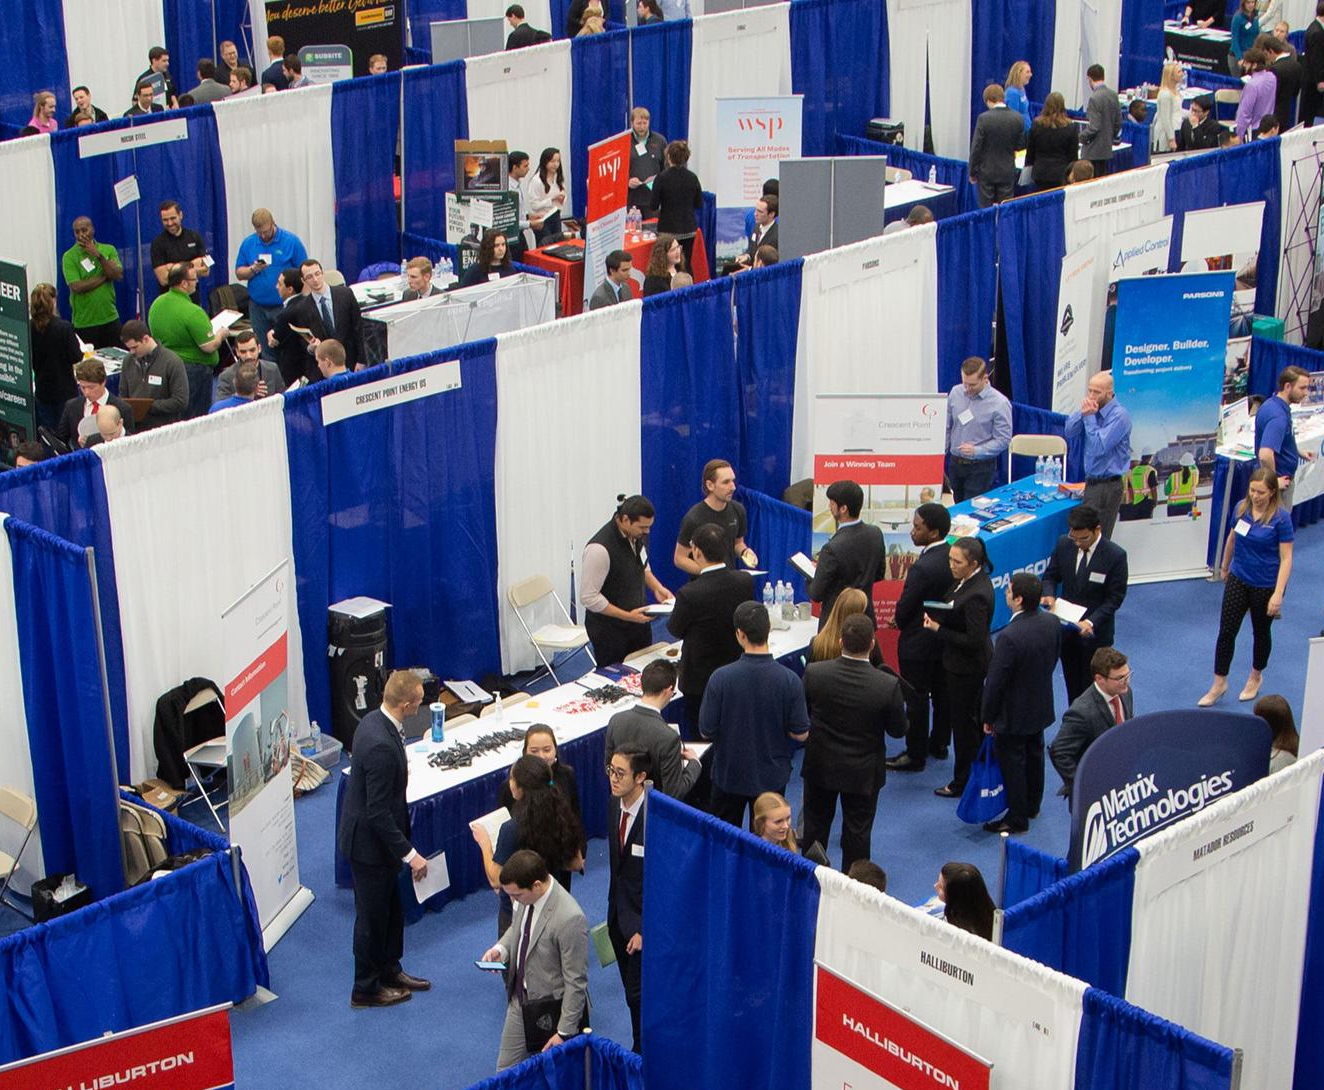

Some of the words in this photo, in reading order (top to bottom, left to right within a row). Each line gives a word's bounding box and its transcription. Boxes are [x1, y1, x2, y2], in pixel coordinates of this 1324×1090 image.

[282, 4, 317, 20] deserve
[737, 117, 784, 140] wsp
[728, 146, 755, 154] Serving
[738, 153, 790, 161] Transportation
[1183, 290, 1225, 300] PARSONS
[1125, 344, 1171, 355] Designer.
[1172, 340, 1209, 351] Builder.
[1125, 356, 1174, 367] Developer.
[355, 390, 381, 405] CRESCENT
[382, 386, 399, 399] POINT
[399, 381, 418, 394] ENERGY
[878, 420, 911, 429] Crescent
[913, 420, 931, 429] Point
[824, 460, 839, 468] Join
[846, 460, 876, 470] Winning
[877, 460, 896, 468] Team
[1101, 773, 1158, 821] Matrix
[1106, 769, 1233, 848] Technologies
[1193, 837, 1222, 861] MATADOR
[1223, 820, 1254, 847] RESOURCES
[920, 950, 975, 987] HALLIBURTON
